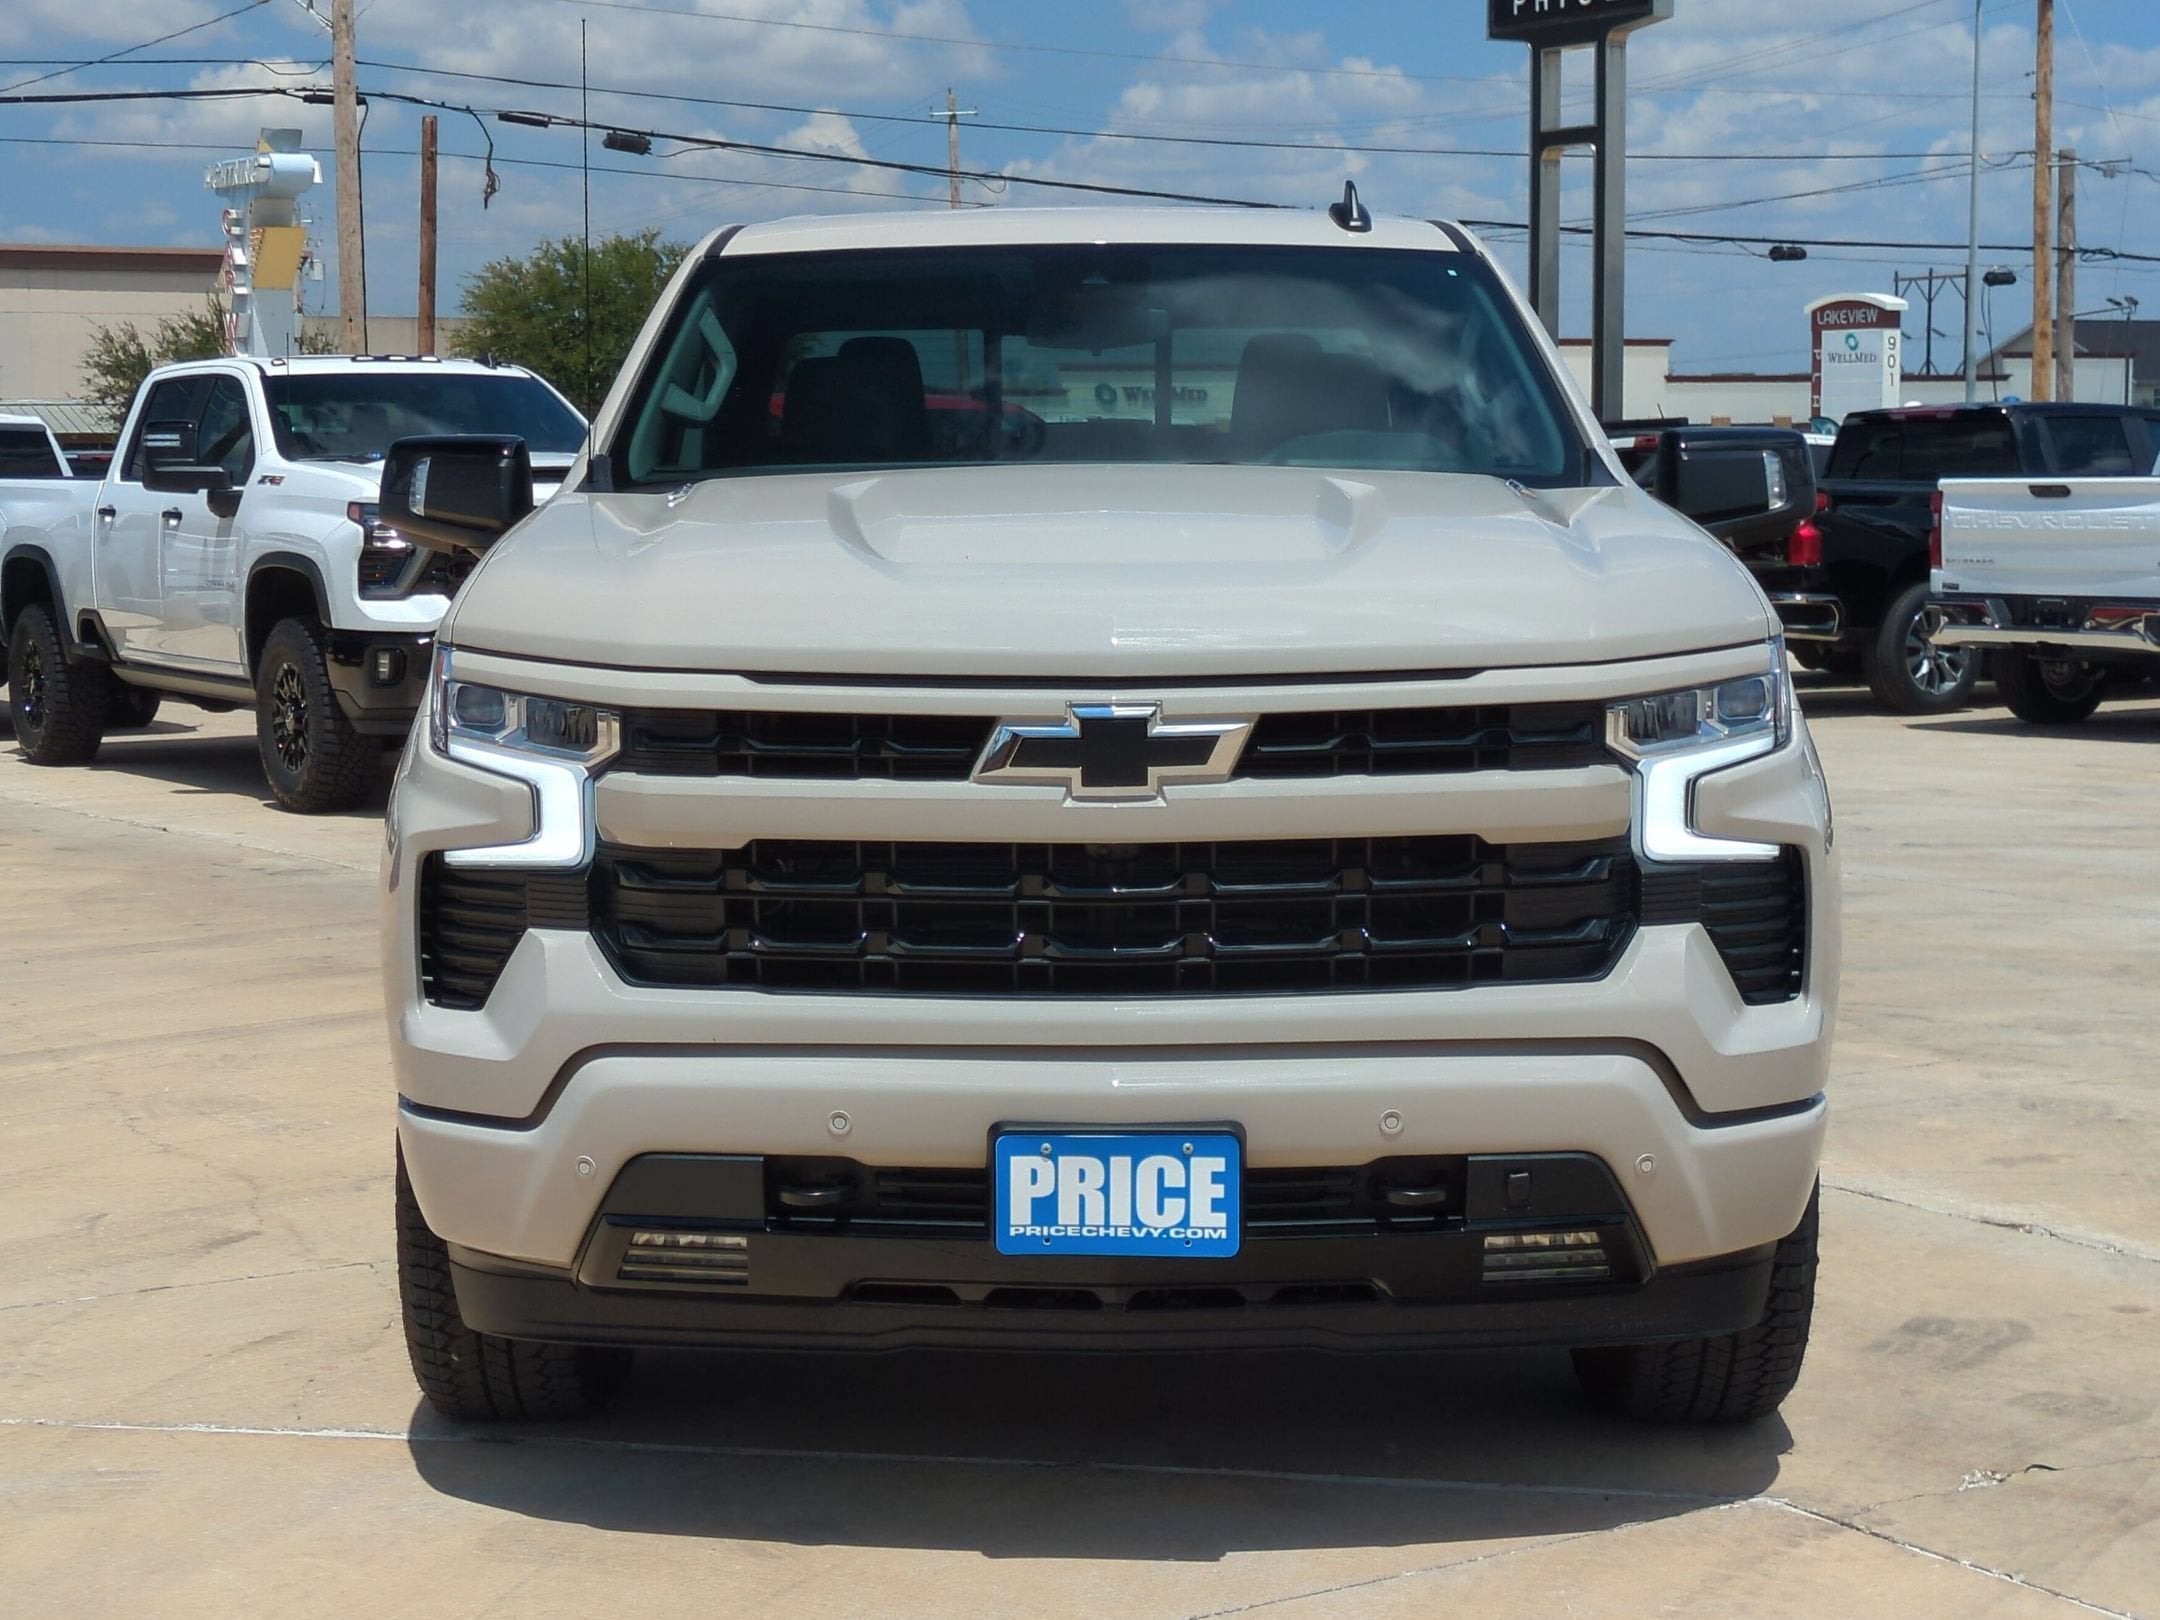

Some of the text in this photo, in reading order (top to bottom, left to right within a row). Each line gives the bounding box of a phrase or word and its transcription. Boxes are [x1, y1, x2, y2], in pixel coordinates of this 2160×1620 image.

[1816, 307, 1879, 325] LAKEVIEW
[1887, 335, 1897, 387] 901
[1953, 514, 2156, 530] CHEVROLET
[1009, 1154, 1228, 1228] PRICE
[1009, 1225, 1228, 1239] PRICECHEVY.COM
